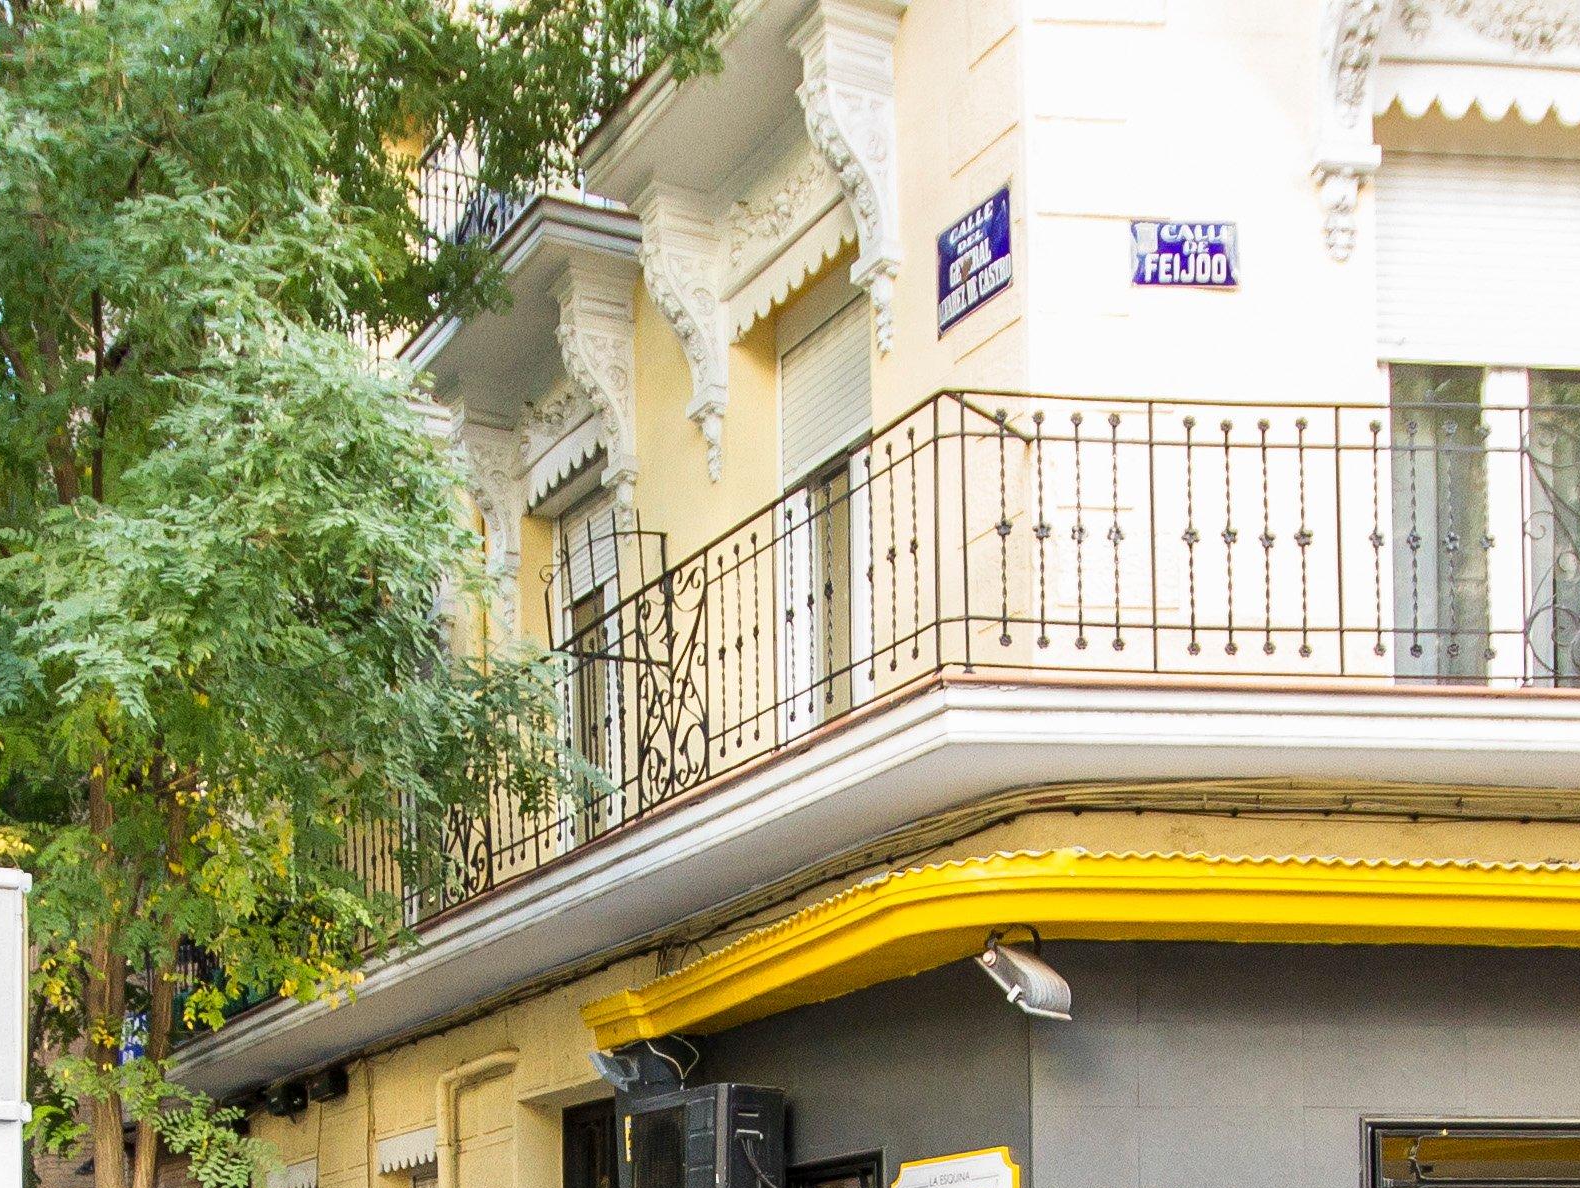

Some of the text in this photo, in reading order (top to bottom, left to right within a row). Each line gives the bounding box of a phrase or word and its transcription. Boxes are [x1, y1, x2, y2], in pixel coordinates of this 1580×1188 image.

[949, 200, 994, 245] CALLE
[957, 229, 983, 256] DEL
[1183, 241, 1209, 255] DE
[978, 253, 1012, 297] CASTRO
[1144, 252, 1227, 283] FEIJOO
[929, 1176, 939, 1187] LA
